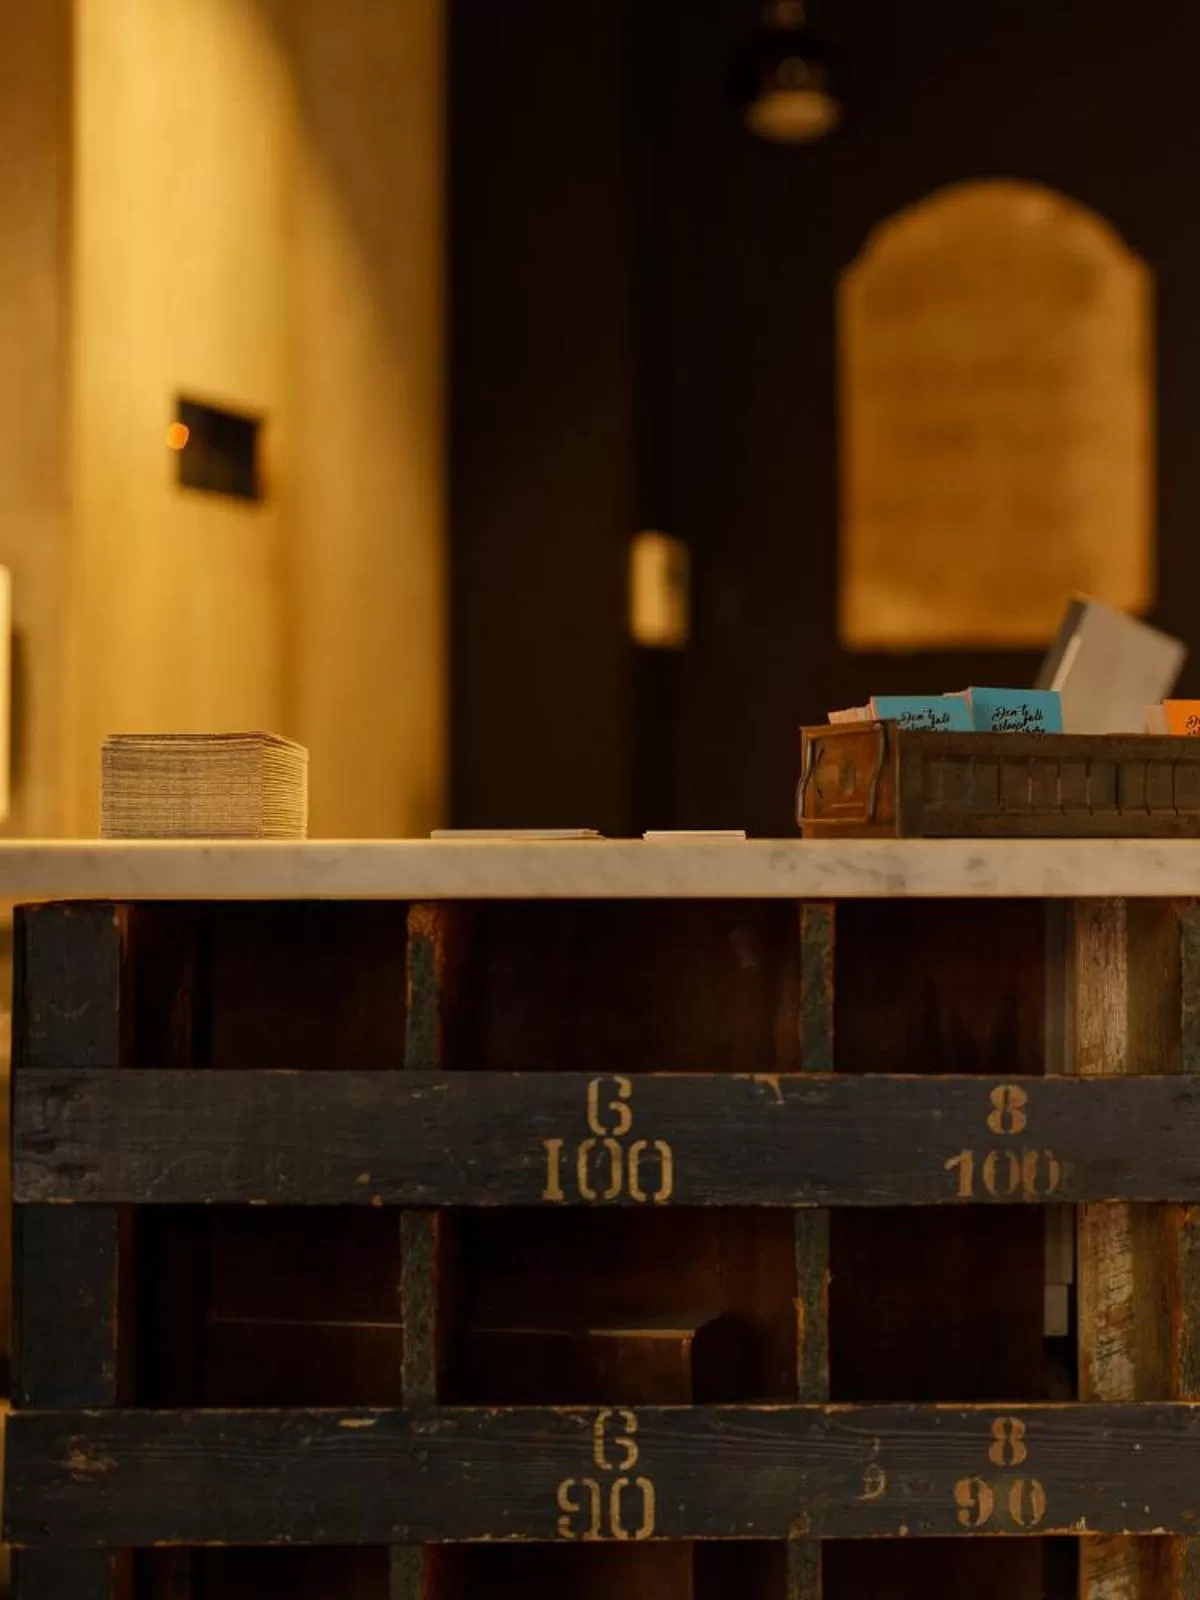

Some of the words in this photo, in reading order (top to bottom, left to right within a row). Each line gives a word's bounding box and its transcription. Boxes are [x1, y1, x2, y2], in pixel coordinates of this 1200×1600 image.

[987, 1084, 1028, 1135] 8
[542, 1137, 673, 1203] 100
[943, 1149, 1060, 1200] 100
[988, 1416, 1027, 1466] 8
[557, 1477, 655, 1540] 90
[955, 1476, 1045, 1527] 90
